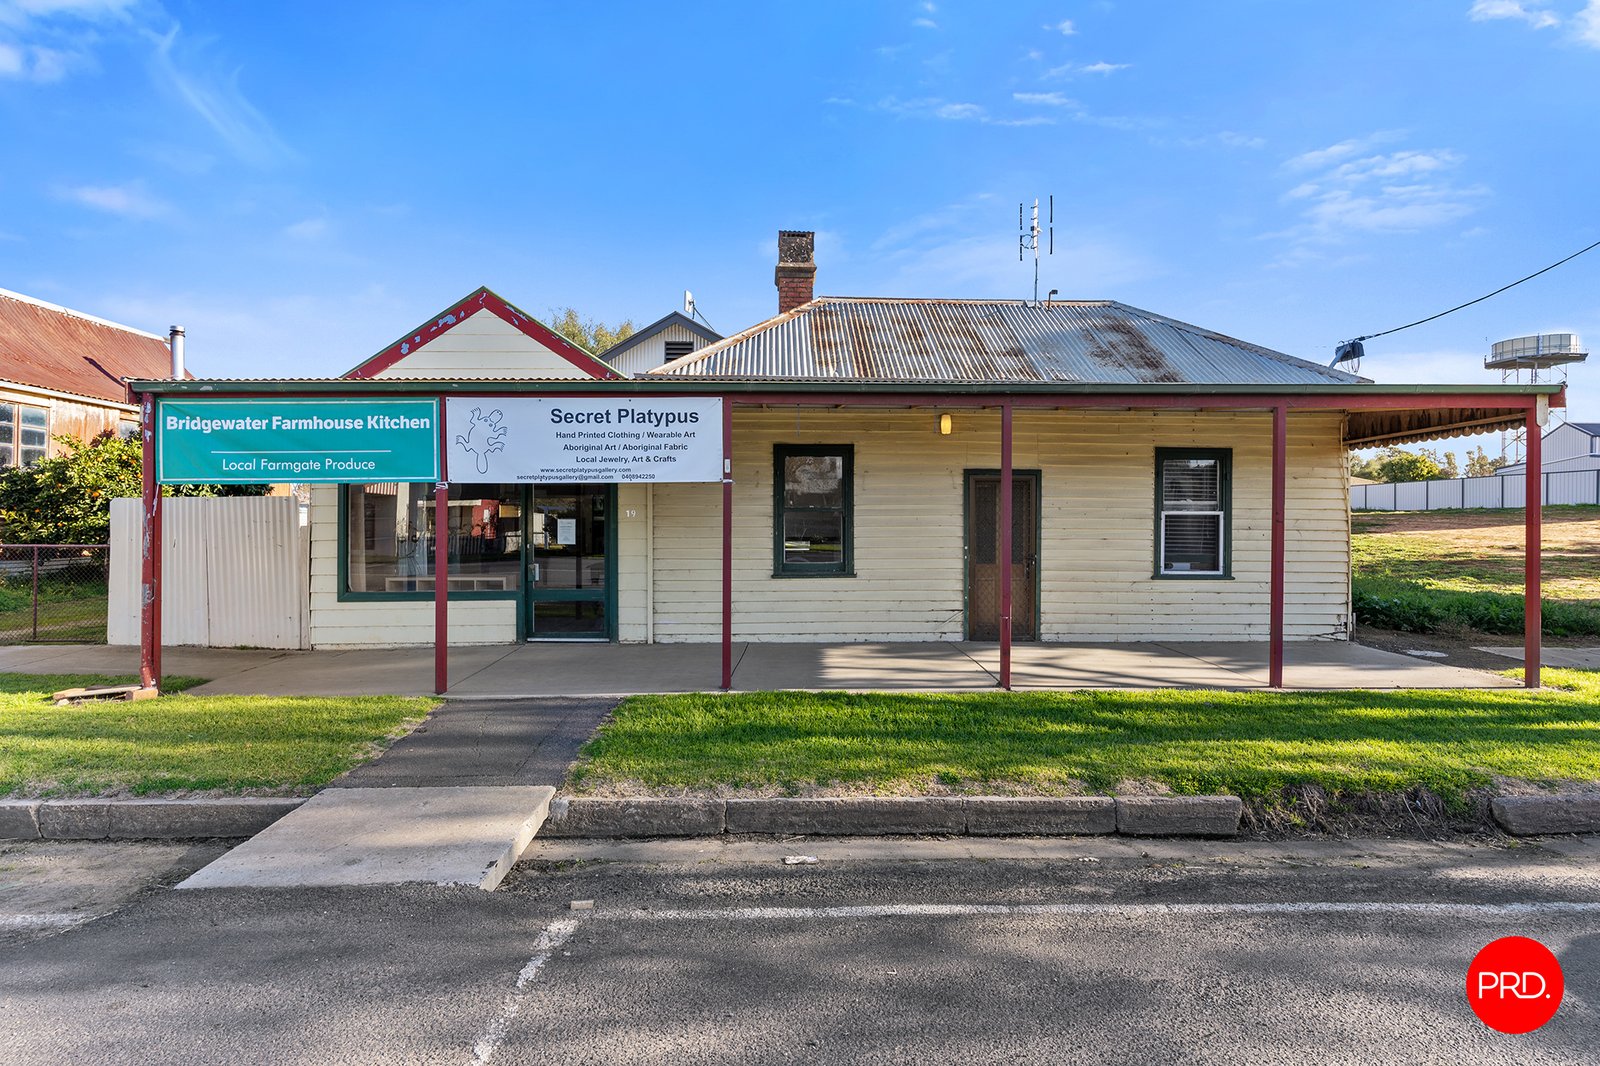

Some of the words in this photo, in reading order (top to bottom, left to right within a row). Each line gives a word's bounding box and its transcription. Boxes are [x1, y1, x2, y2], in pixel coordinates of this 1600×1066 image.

[551, 408, 612, 424] Secret
[618, 408, 700, 428] Platypus
[166, 415, 268, 434] Bridgewater
[272, 415, 364, 431] Farmhouse
[367, 413, 431, 430] Kitchen
[555, 431, 576, 439] Hand
[578, 431, 606, 439] Printed
[608, 431, 641, 440] Clothing
[647, 431, 682, 439] Wearable
[684, 431, 696, 439] Art
[563, 443, 603, 452] Aboriginal
[622, 443, 662, 452] Aboriginal
[664, 443, 689, 451] Fabric
[575, 455, 597, 463] Local
[598, 455, 630, 464] Jewelry,
[631, 455, 643, 463] Art
[645, 455, 652, 463] &
[653, 455, 677, 463] Crafts
[222, 458, 256, 471] Local
[260, 457, 321, 474] Farmgate
[325, 457, 376, 471] Produce
[540, 466, 632, 474] www.secretplatypusgallery.com
[516, 473, 614, 481] secretplatypusgallery@gmail.com
[625, 509, 637, 518] 19
